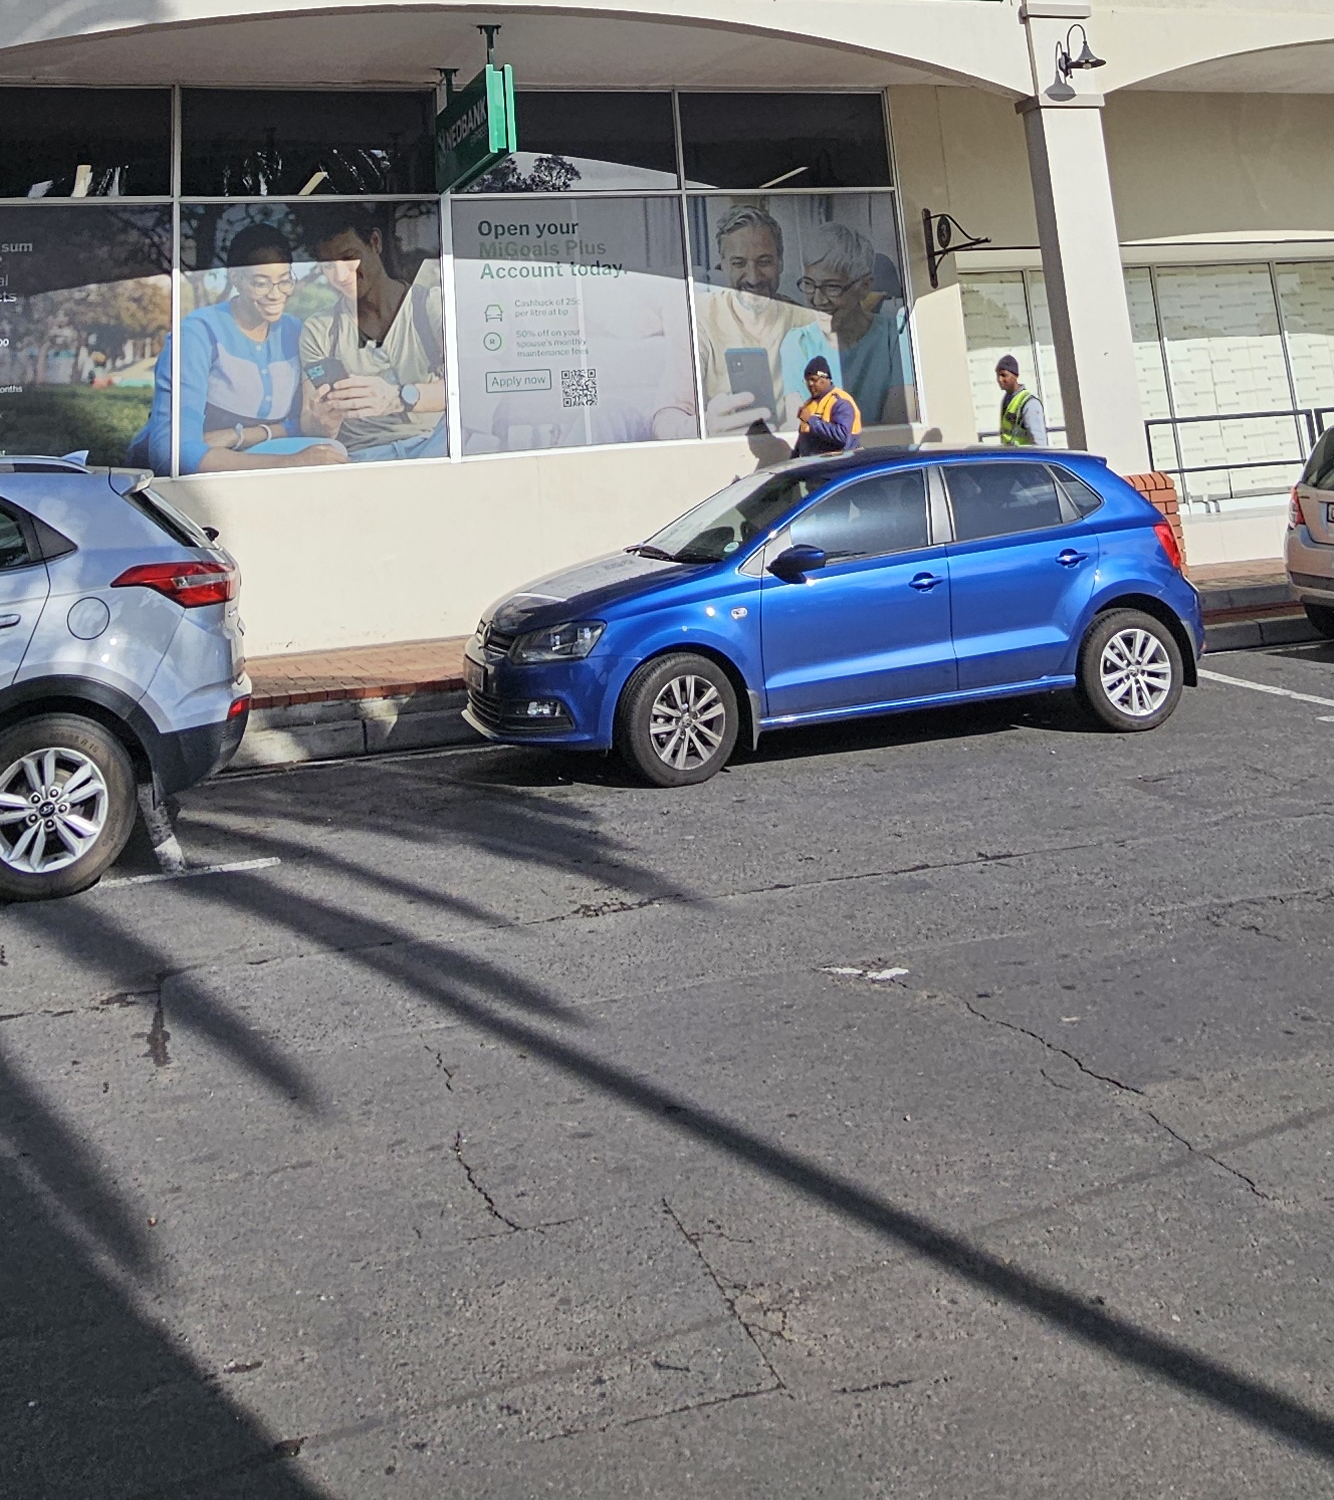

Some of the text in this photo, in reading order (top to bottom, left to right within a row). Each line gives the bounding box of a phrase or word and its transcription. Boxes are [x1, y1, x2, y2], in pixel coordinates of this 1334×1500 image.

[478, 220, 579, 239] Open your
[2, 242, 33, 252] sum
[479, 239, 606, 258] MiGoals Plus
[480, 260, 627, 279] Account today.
[515, 298, 554, 308] Cashback
[555, 298, 565, 306] of
[515, 308, 568, 318] per litre at bp
[516, 330, 536, 338] 50%
[537, 329, 549, 337] off
[563, 329, 580, 338] your
[516, 340, 553, 349] spouse's
[517, 349, 570, 358] maintenance
[491, 375, 546, 387] Apply now
